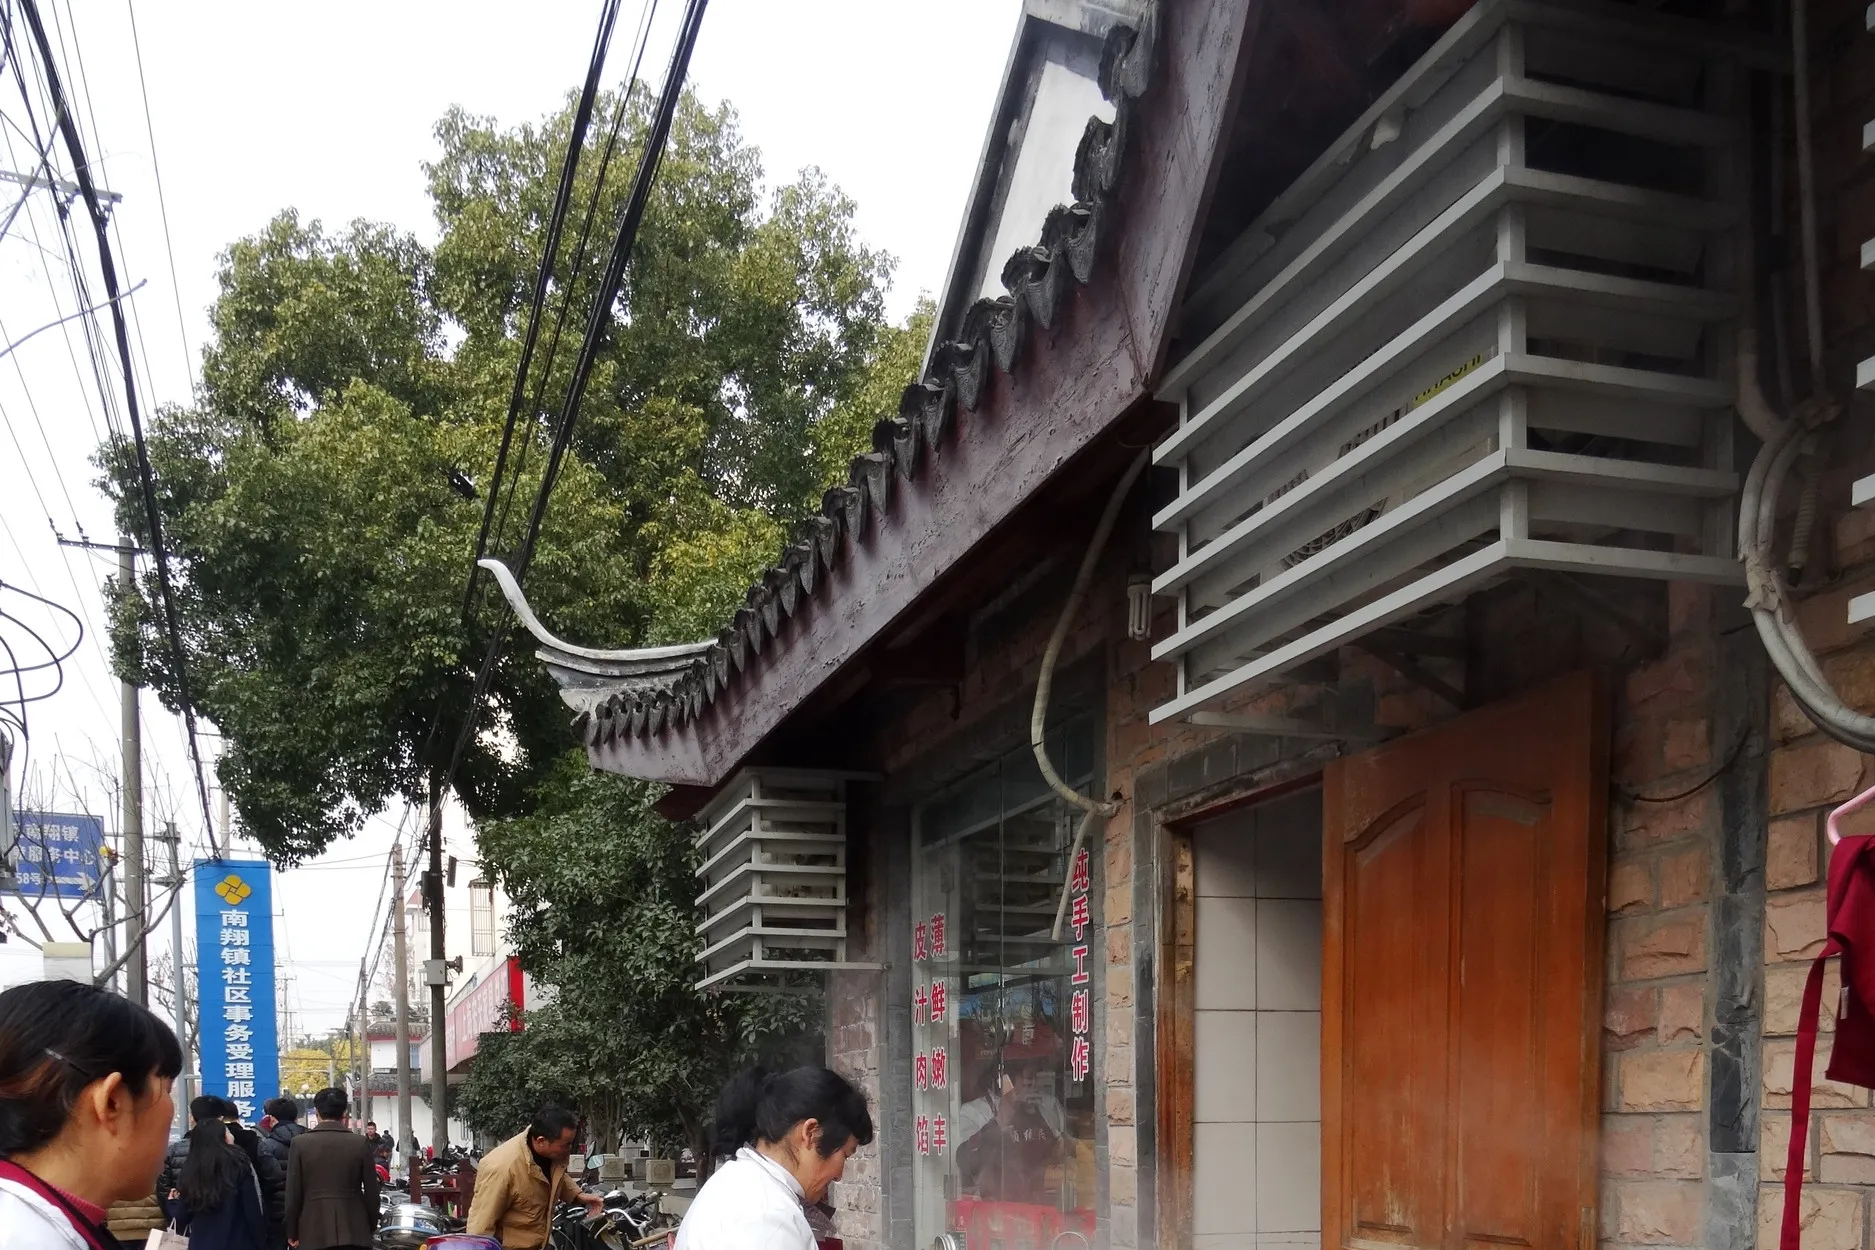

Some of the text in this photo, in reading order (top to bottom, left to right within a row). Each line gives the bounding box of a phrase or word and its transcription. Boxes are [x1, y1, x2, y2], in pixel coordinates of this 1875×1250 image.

[1071, 848, 1090, 1082] 纯手工制作
